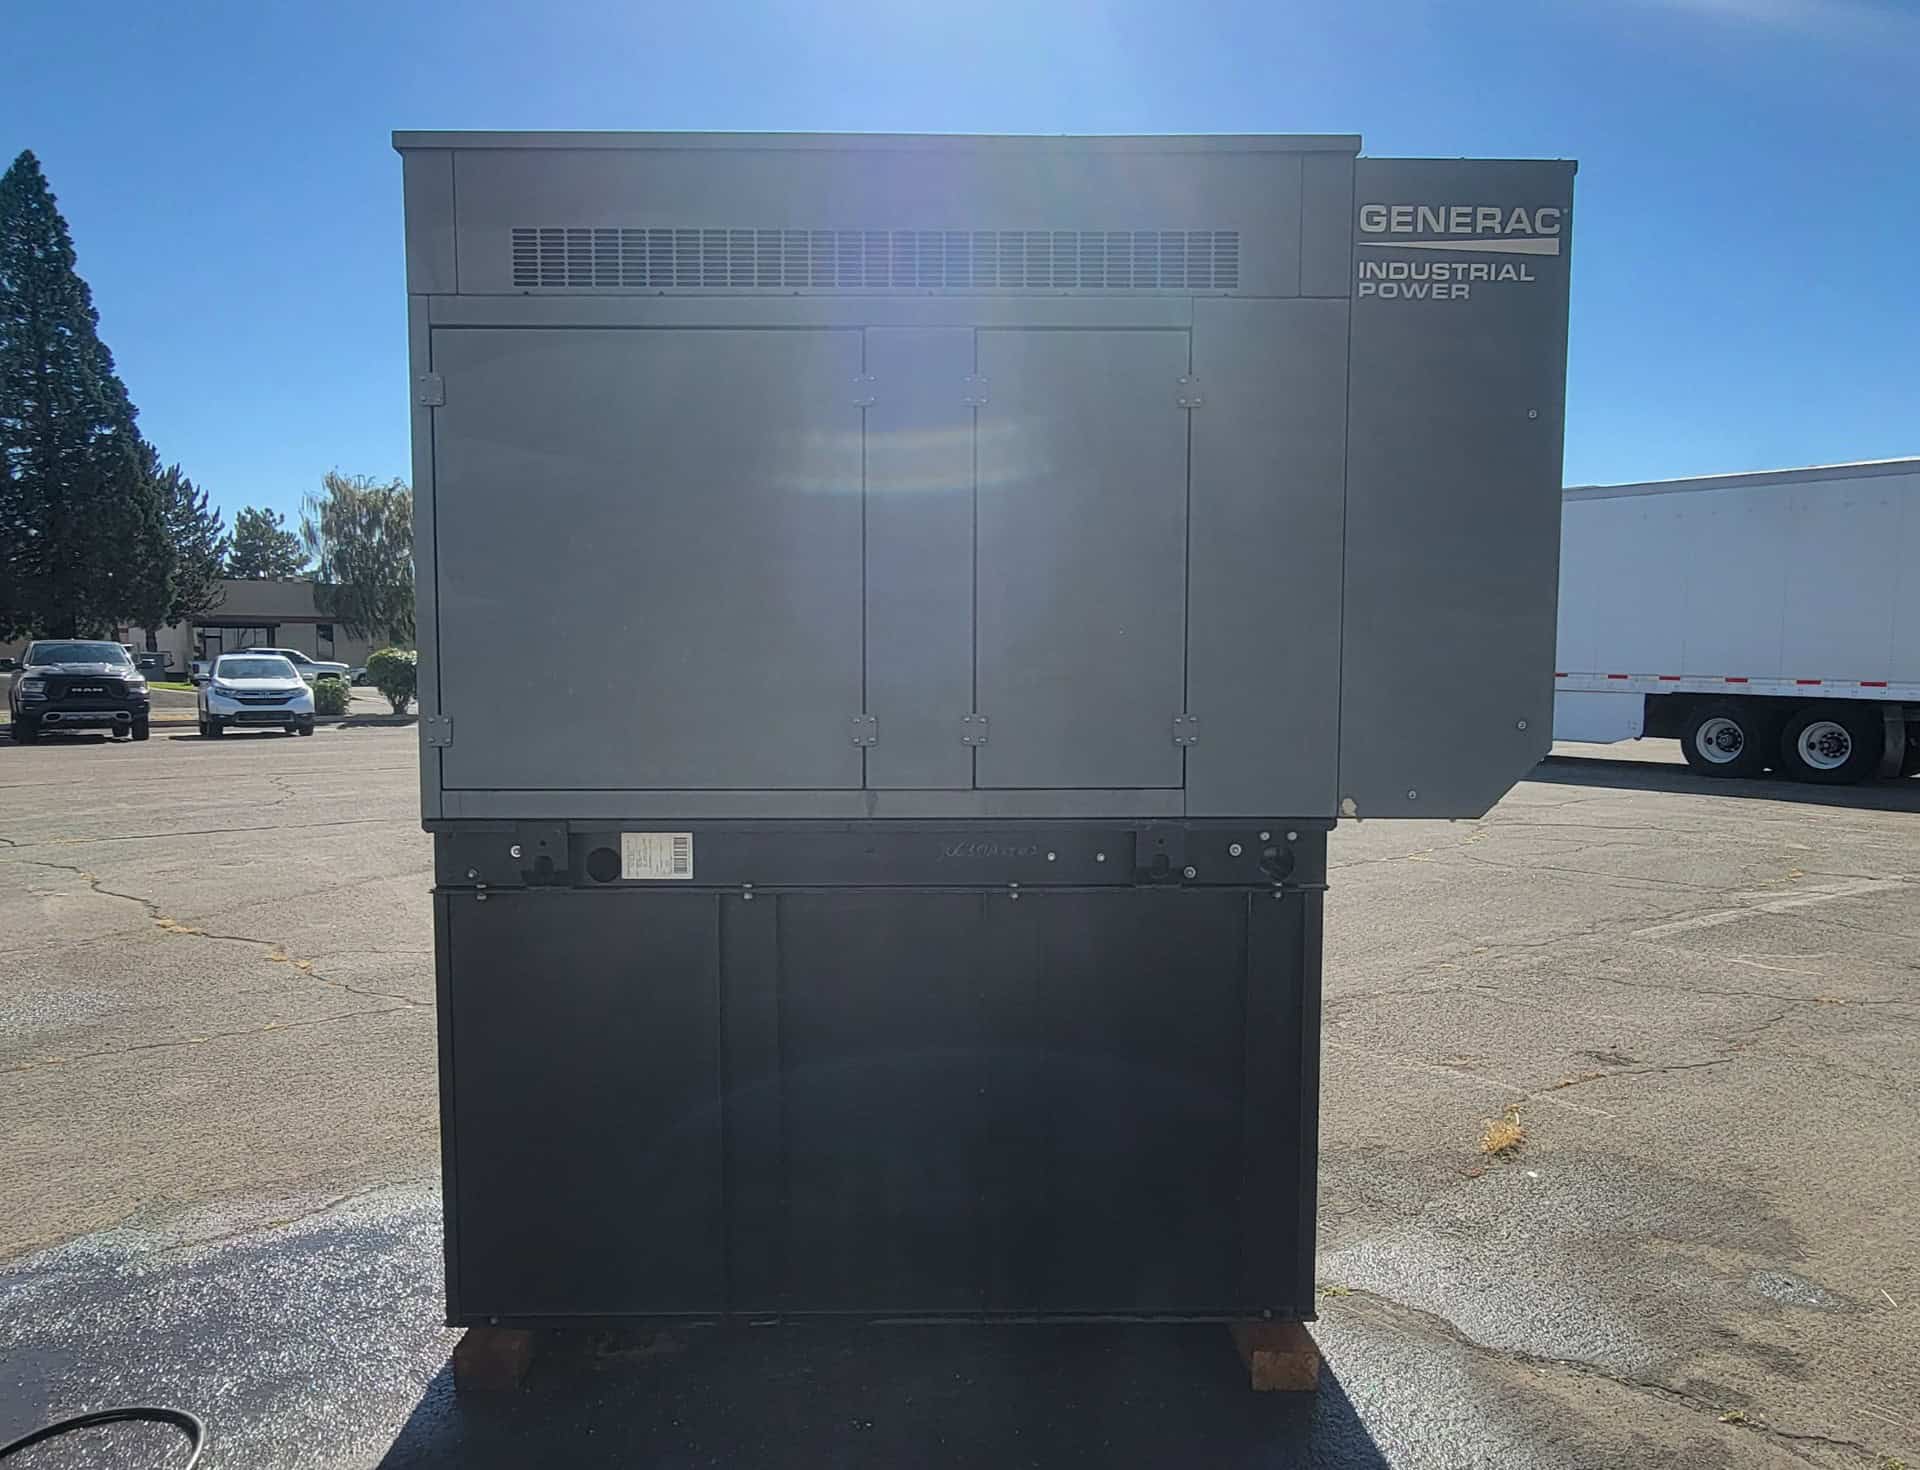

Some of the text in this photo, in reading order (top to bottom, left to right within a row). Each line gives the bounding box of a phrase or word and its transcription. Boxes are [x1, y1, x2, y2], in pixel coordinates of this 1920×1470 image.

[1359, 204, 1561, 235] GENERAC
[1358, 261, 1535, 281] INDUSTRIAL
[1358, 282, 1470, 300] POWER
